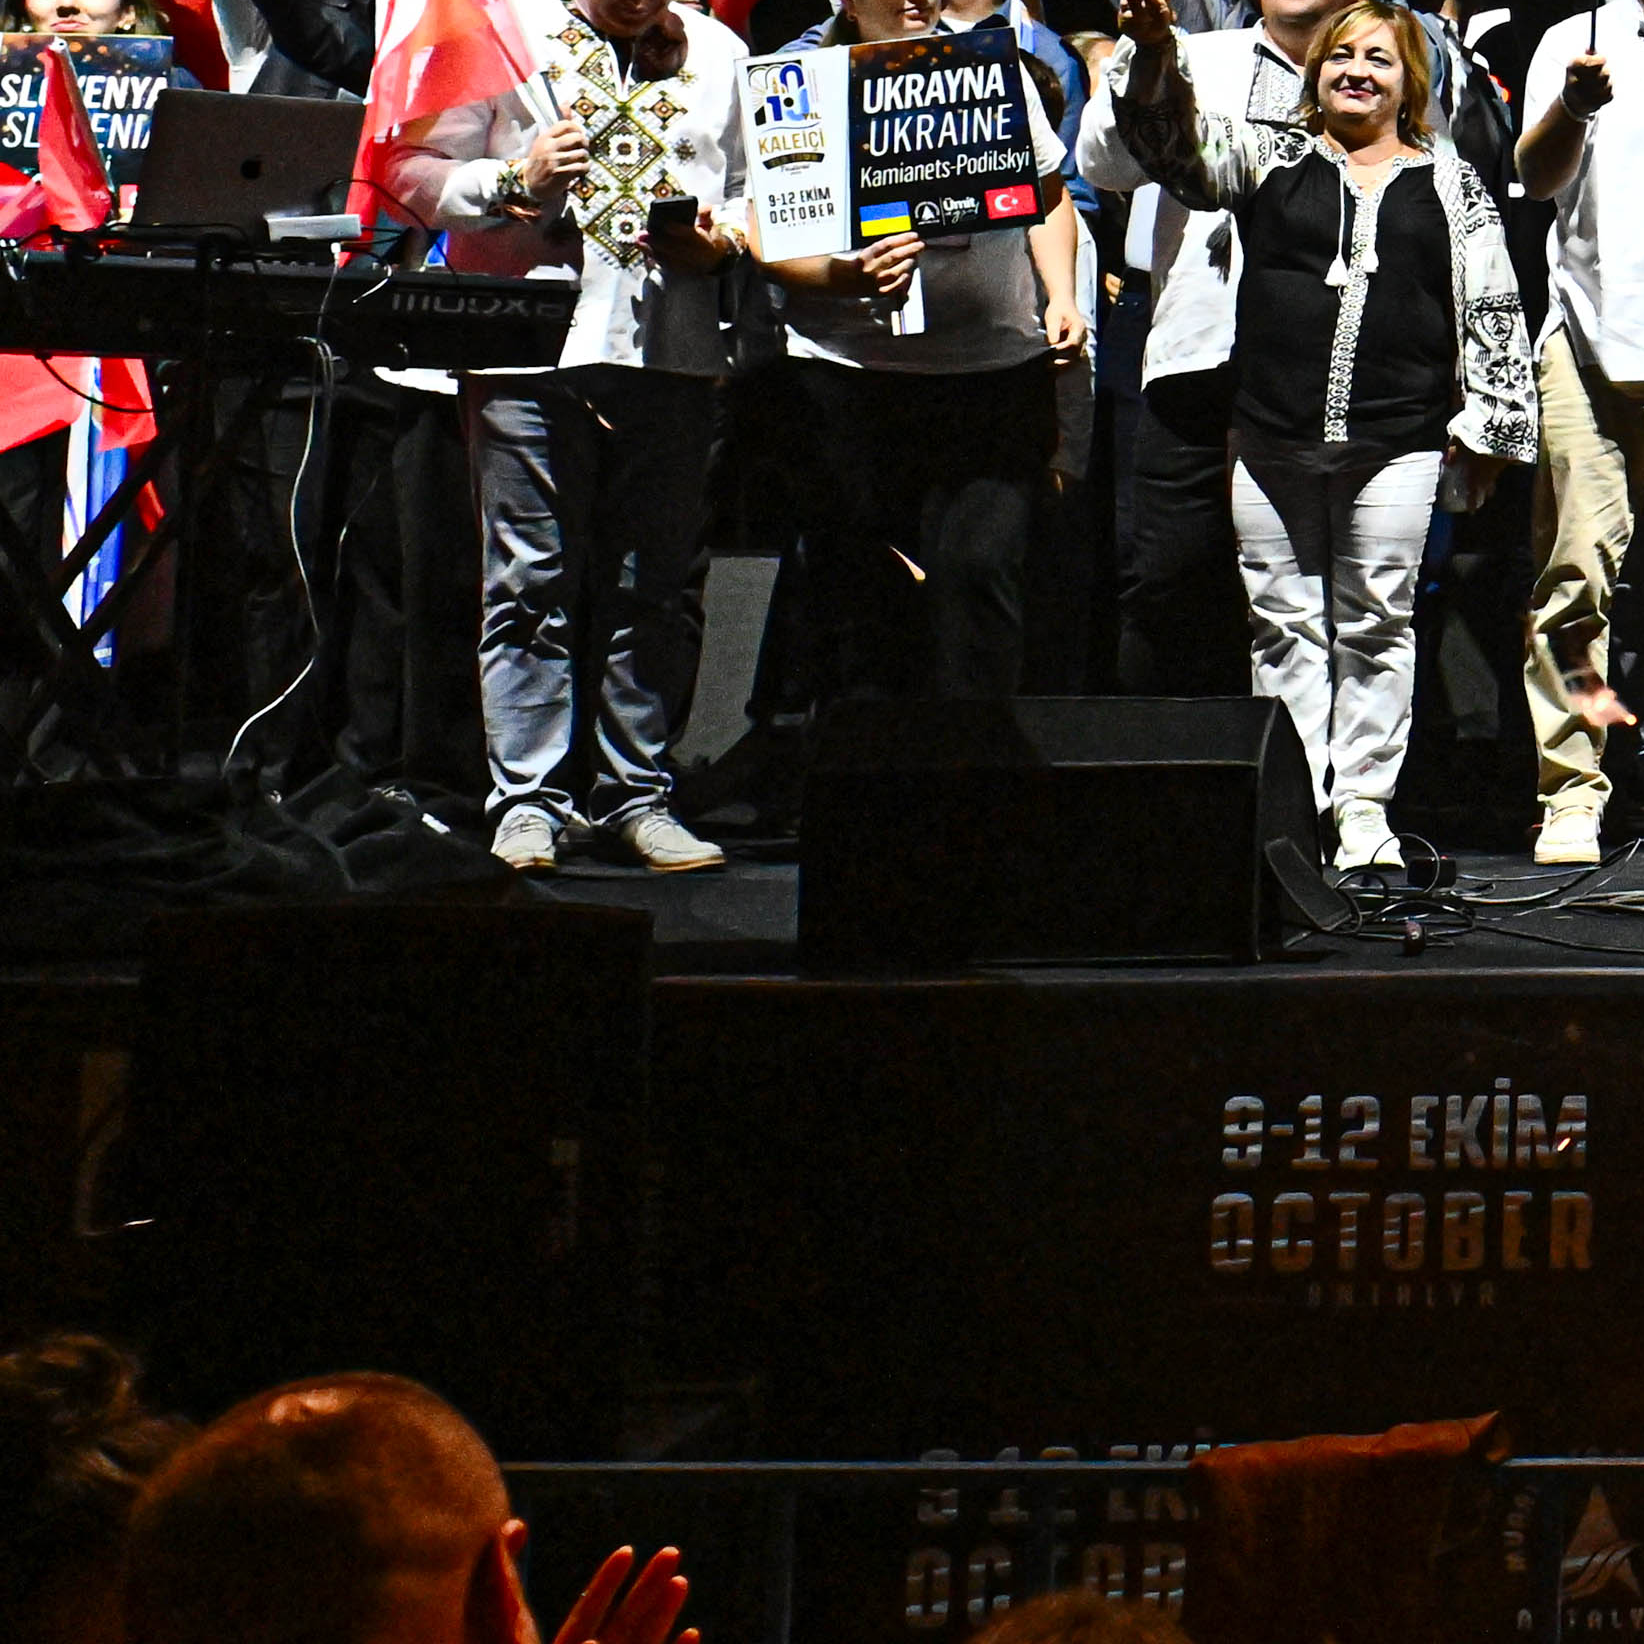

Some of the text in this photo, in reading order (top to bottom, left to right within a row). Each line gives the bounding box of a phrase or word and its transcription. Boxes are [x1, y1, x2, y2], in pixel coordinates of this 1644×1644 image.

[863, 63, 1005, 114] UKRAYNA
[758, 129, 825, 155] KALEİÇİ
[869, 103, 1013, 157] UKRAINE
[860, 145, 1031, 189] Kamianets-Podilskyi
[768, 186, 831, 208] 9-12 EKİM
[769, 203, 835, 224] OCTOBER
[1221, 1076, 1589, 1171] 9-12 EKİM
[1209, 1189, 1594, 1275] OCTOBER
